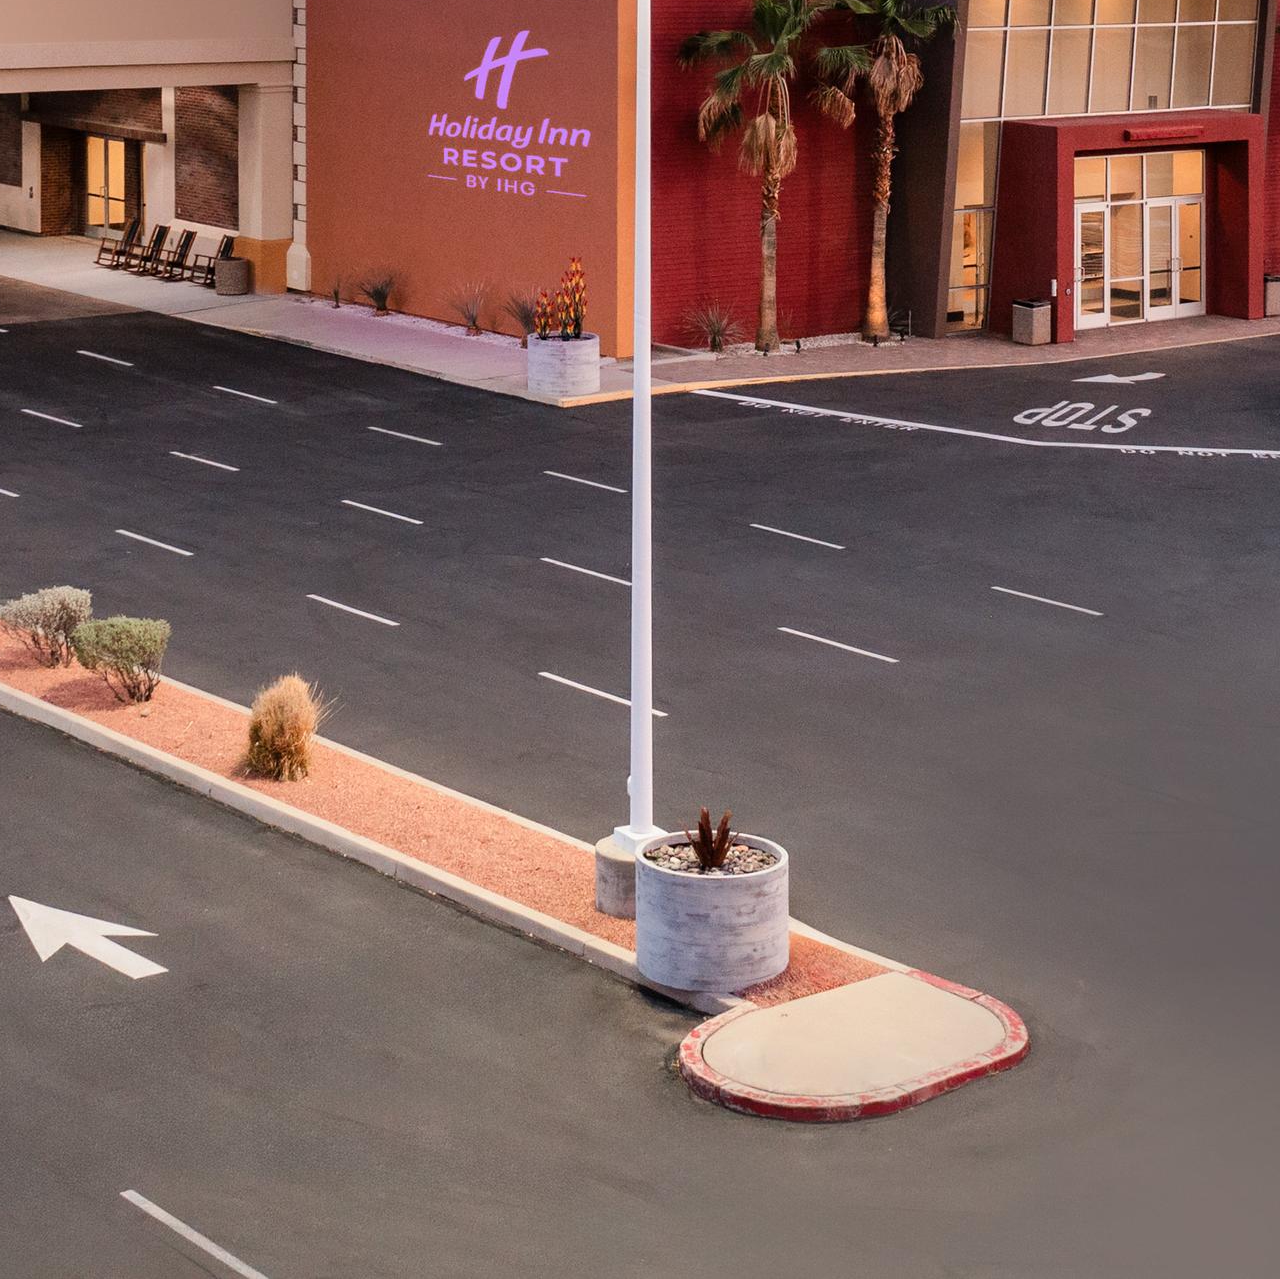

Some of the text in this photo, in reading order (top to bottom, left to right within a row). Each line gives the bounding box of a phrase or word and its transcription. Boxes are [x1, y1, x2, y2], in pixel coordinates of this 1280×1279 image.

[428, 113, 591, 149] Holiday Inn
[442, 147, 569, 177] RESORT
[466, 175, 536, 196] BY IHG
[1013, 400, 1152, 434] STOP
